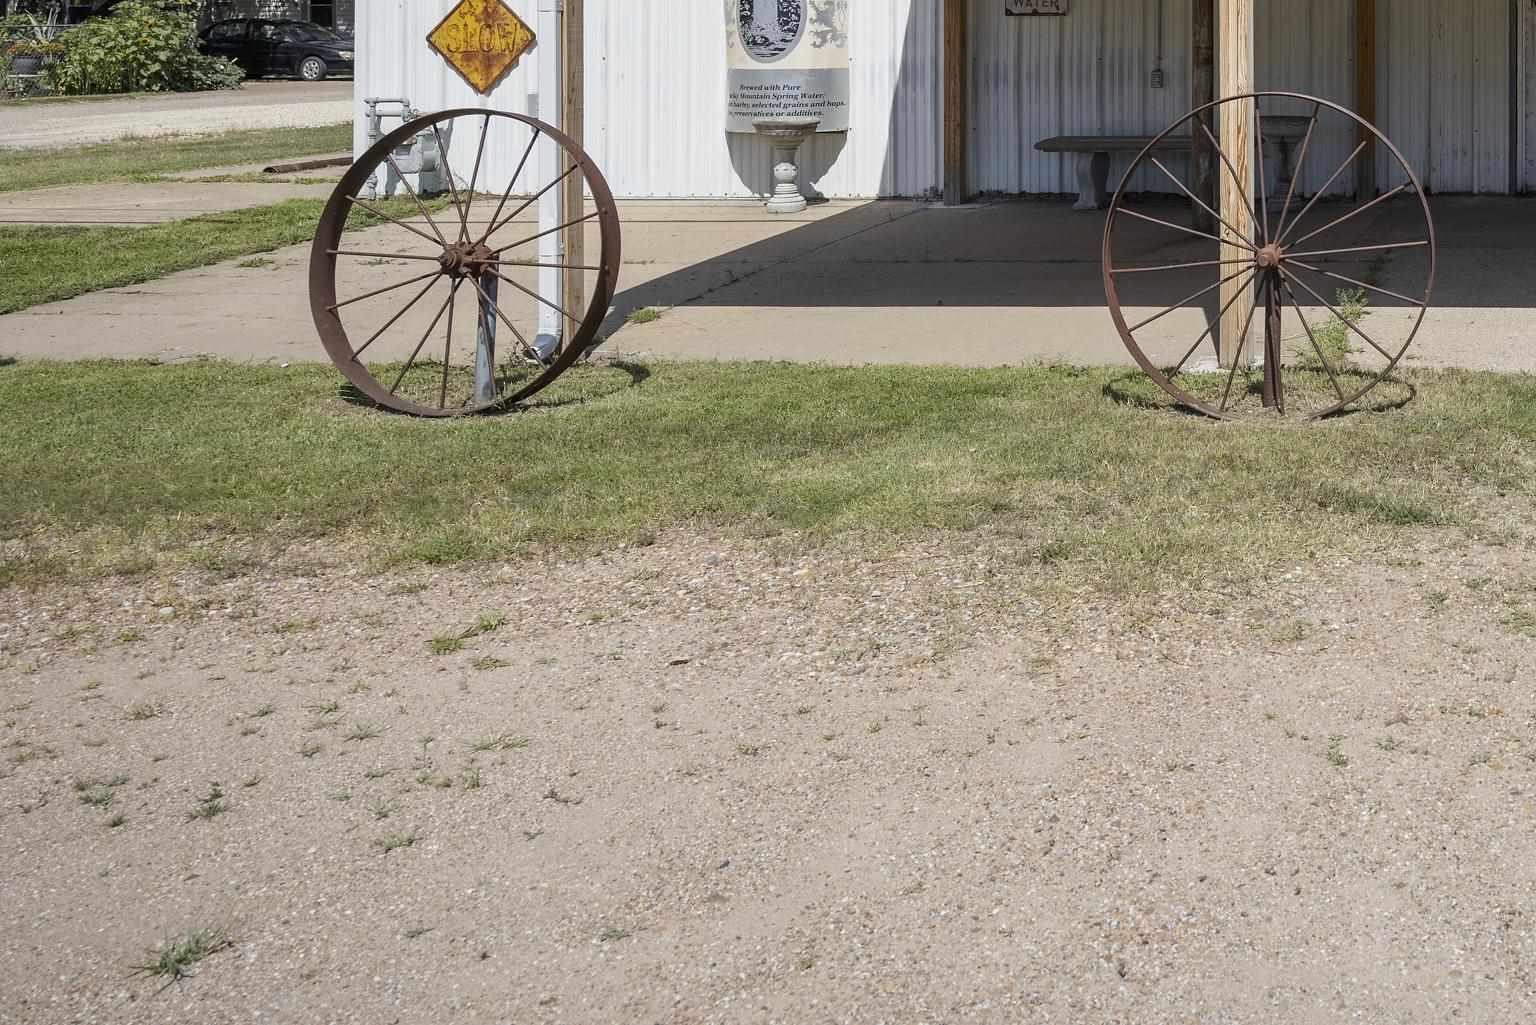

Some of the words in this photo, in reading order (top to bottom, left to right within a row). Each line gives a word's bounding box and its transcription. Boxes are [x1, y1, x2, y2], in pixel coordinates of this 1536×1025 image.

[446, 21, 518, 54] SLOW
[772, 93, 799, 101] Spring
[782, 101, 809, 110] grains
